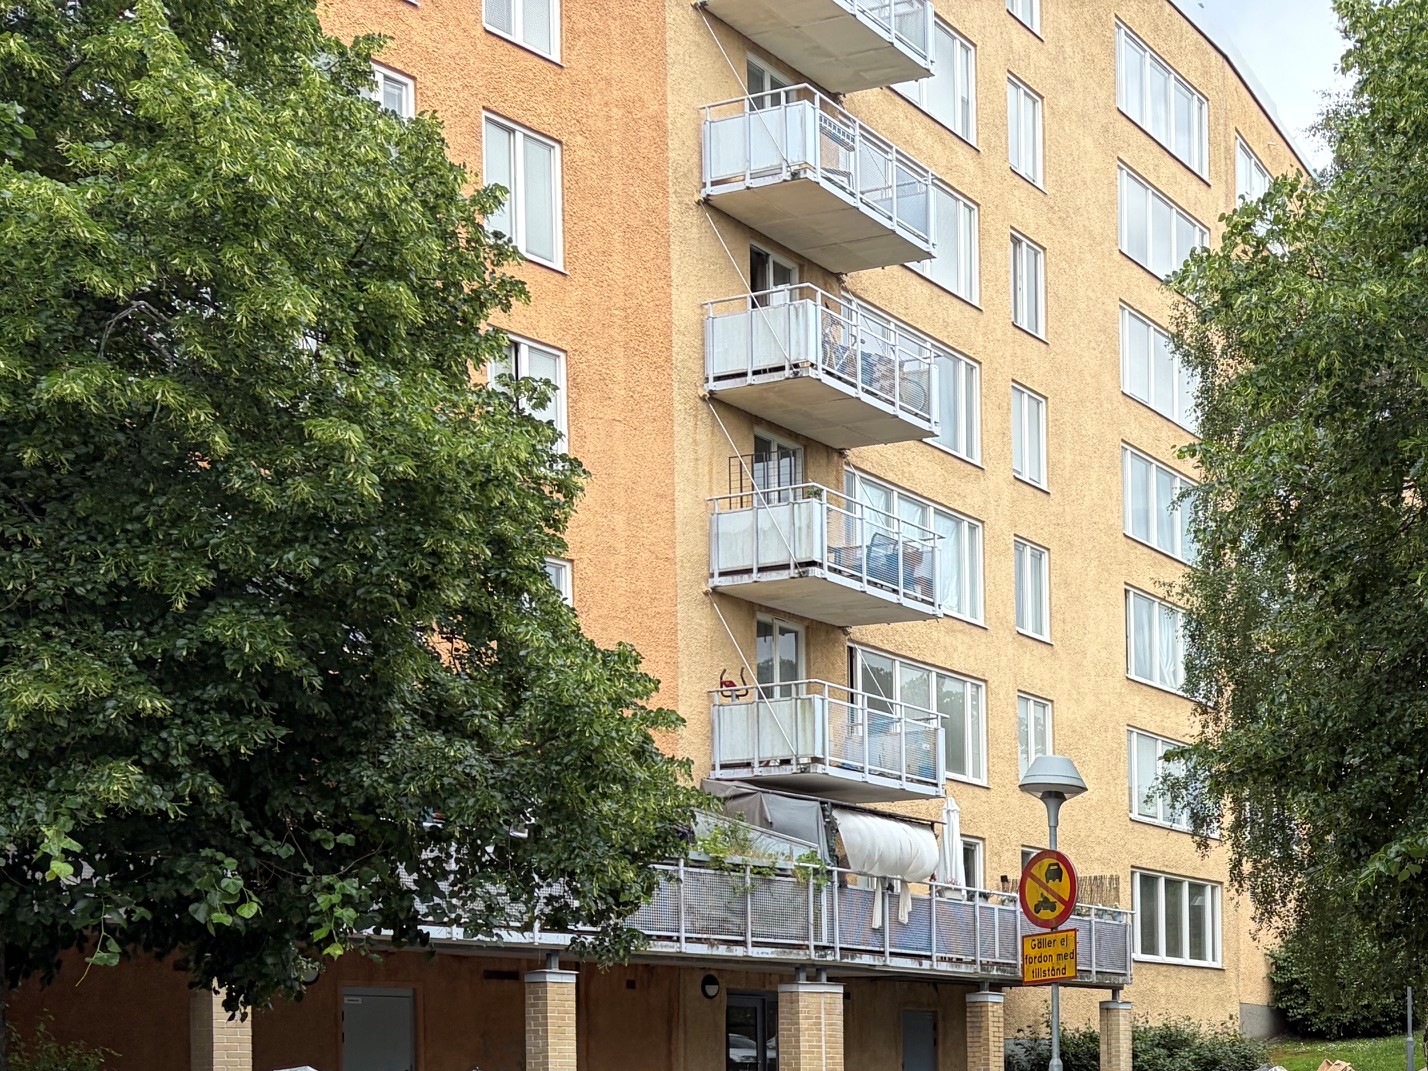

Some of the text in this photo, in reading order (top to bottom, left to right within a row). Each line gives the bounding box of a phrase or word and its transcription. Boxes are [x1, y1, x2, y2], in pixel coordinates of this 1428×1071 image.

[1031, 934, 1068, 950] Gäller ej
[1025, 949, 1074, 965] fordon med
[1032, 964, 1067, 979] tillstånd
